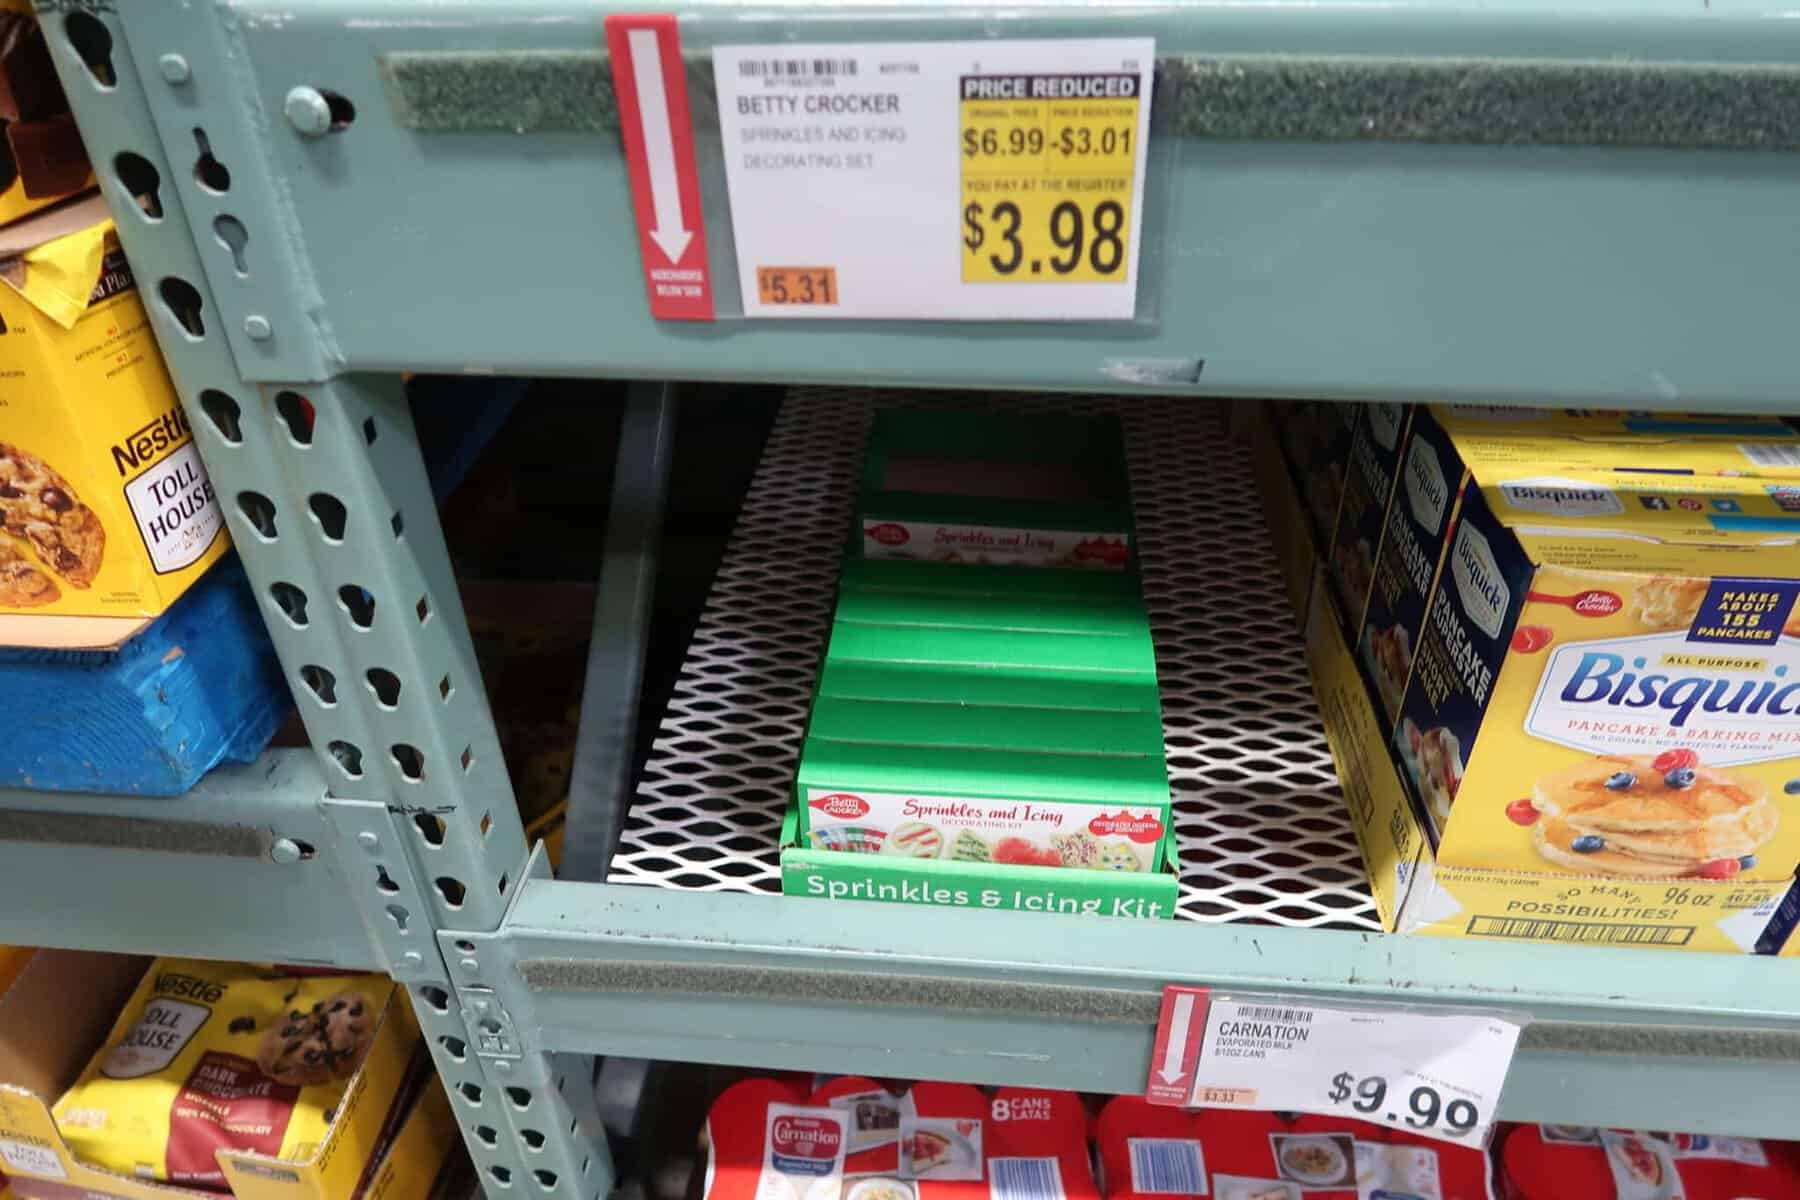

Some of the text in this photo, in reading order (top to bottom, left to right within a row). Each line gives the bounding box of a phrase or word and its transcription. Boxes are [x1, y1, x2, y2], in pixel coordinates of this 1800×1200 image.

[965, 77, 1135, 97] PRICE REDUCED
[737, 93, 900, 115] BETTY CROCKER
[828, 127, 859, 143] AND
[863, 126, 907, 144] ICING
[964, 127, 1044, 158] $6.99
[1050, 126, 1131, 157] -$3.01
[744, 152, 873, 170] DECORATING SET
[967, 178, 1127, 192] YOU PAY AT THE REGISTER
[964, 200, 1125, 275] $3.98
[760, 272, 831, 304] $5.31
[148, 461, 199, 507] TOLL
[1512, 486, 1608, 503] Bisquick
[149, 479, 215, 543] HOUSE
[1459, 532, 1501, 614] Bisquick
[1718, 602, 1776, 611] ABOUT
[1723, 592, 1780, 602] MAKES
[1722, 614, 1759, 627] 155
[1438, 583, 1492, 692] PANCAKE
[1697, 627, 1773, 640] PANCAKES
[1433, 601, 1486, 707] SUPERSTAR
[1667, 657, 1761, 669] ALL PURPOSE
[1561, 652, 1800, 727] Bisquic
[1568, 719, 1659, 737] PANCAKE
[1666, 727, 1679, 737] &
[1686, 730, 1761, 742] BAKING
[824, 803, 865, 816] Crocker
[831, 796, 858, 808] Betty
[903, 799, 1064, 826] Sprinkles and Icing
[941, 818, 1023, 830] DECORATING KIT
[807, 875, 1163, 919] Sprinkles & Icing Kit
[1664, 887, 1691, 905] 96
[1507, 900, 1679, 920] POSSIBILITIES!
[144, 1007, 181, 1029] OLL
[1218, 1020, 1310, 1041] CARNATION
[1216, 1037, 1273, 1049] EVAPORATED
[1242, 1050, 1266, 1059] CANS
[199, 1065, 240, 1084] DARK
[992, 1097, 1051, 1121] 8 CANS
[1011, 1109, 1051, 1120] LATAS
[1327, 1071, 1479, 1138] $9.99
[774, 1120, 839, 1145] Carnation
